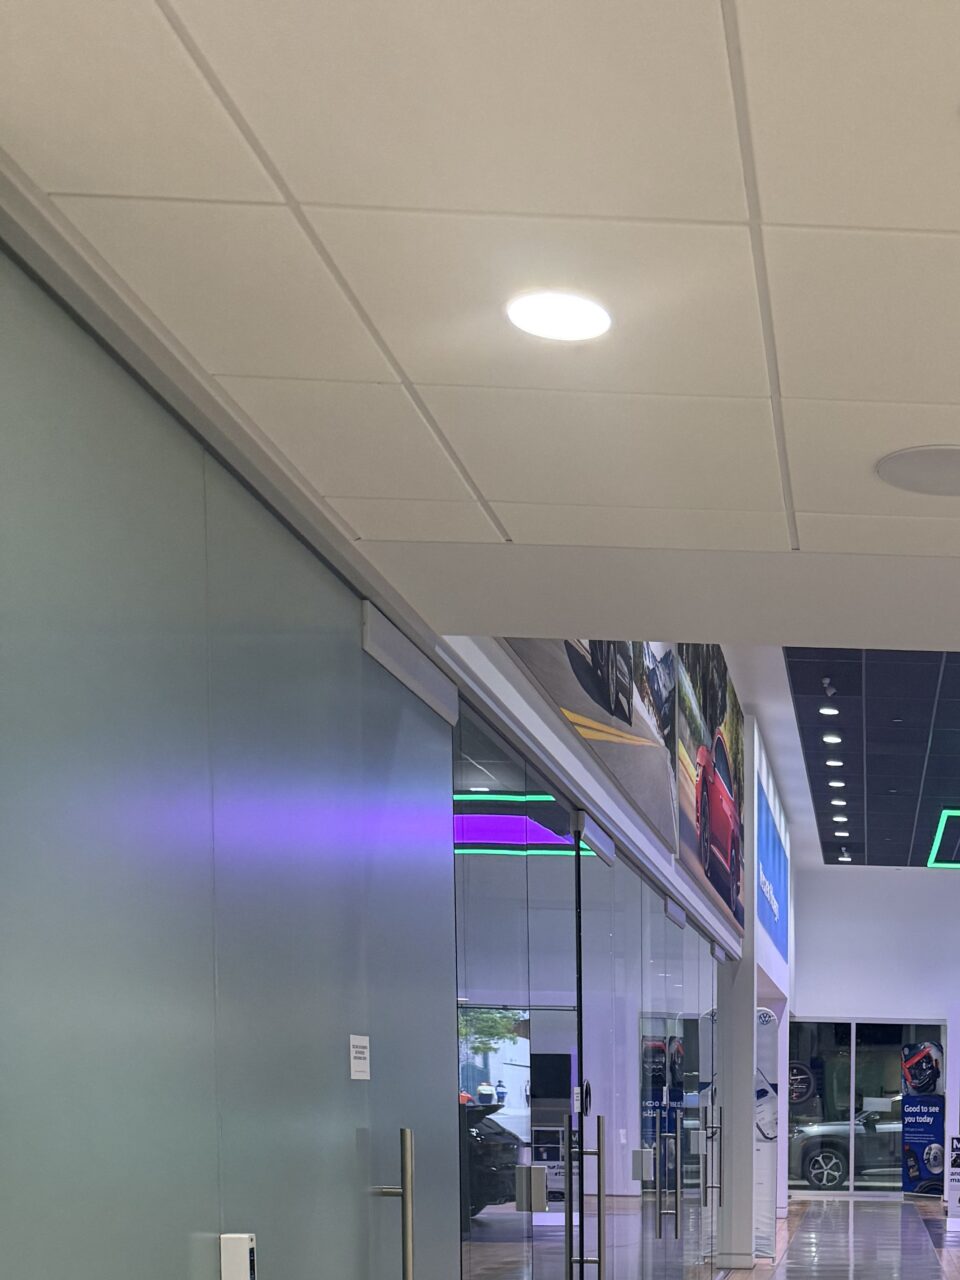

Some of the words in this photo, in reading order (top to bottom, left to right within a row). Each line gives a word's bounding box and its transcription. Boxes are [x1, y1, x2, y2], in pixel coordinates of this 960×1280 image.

[904, 1105, 920, 1113] Good
[921, 1105, 928, 1113] to
[916, 1115, 934, 1125] today
